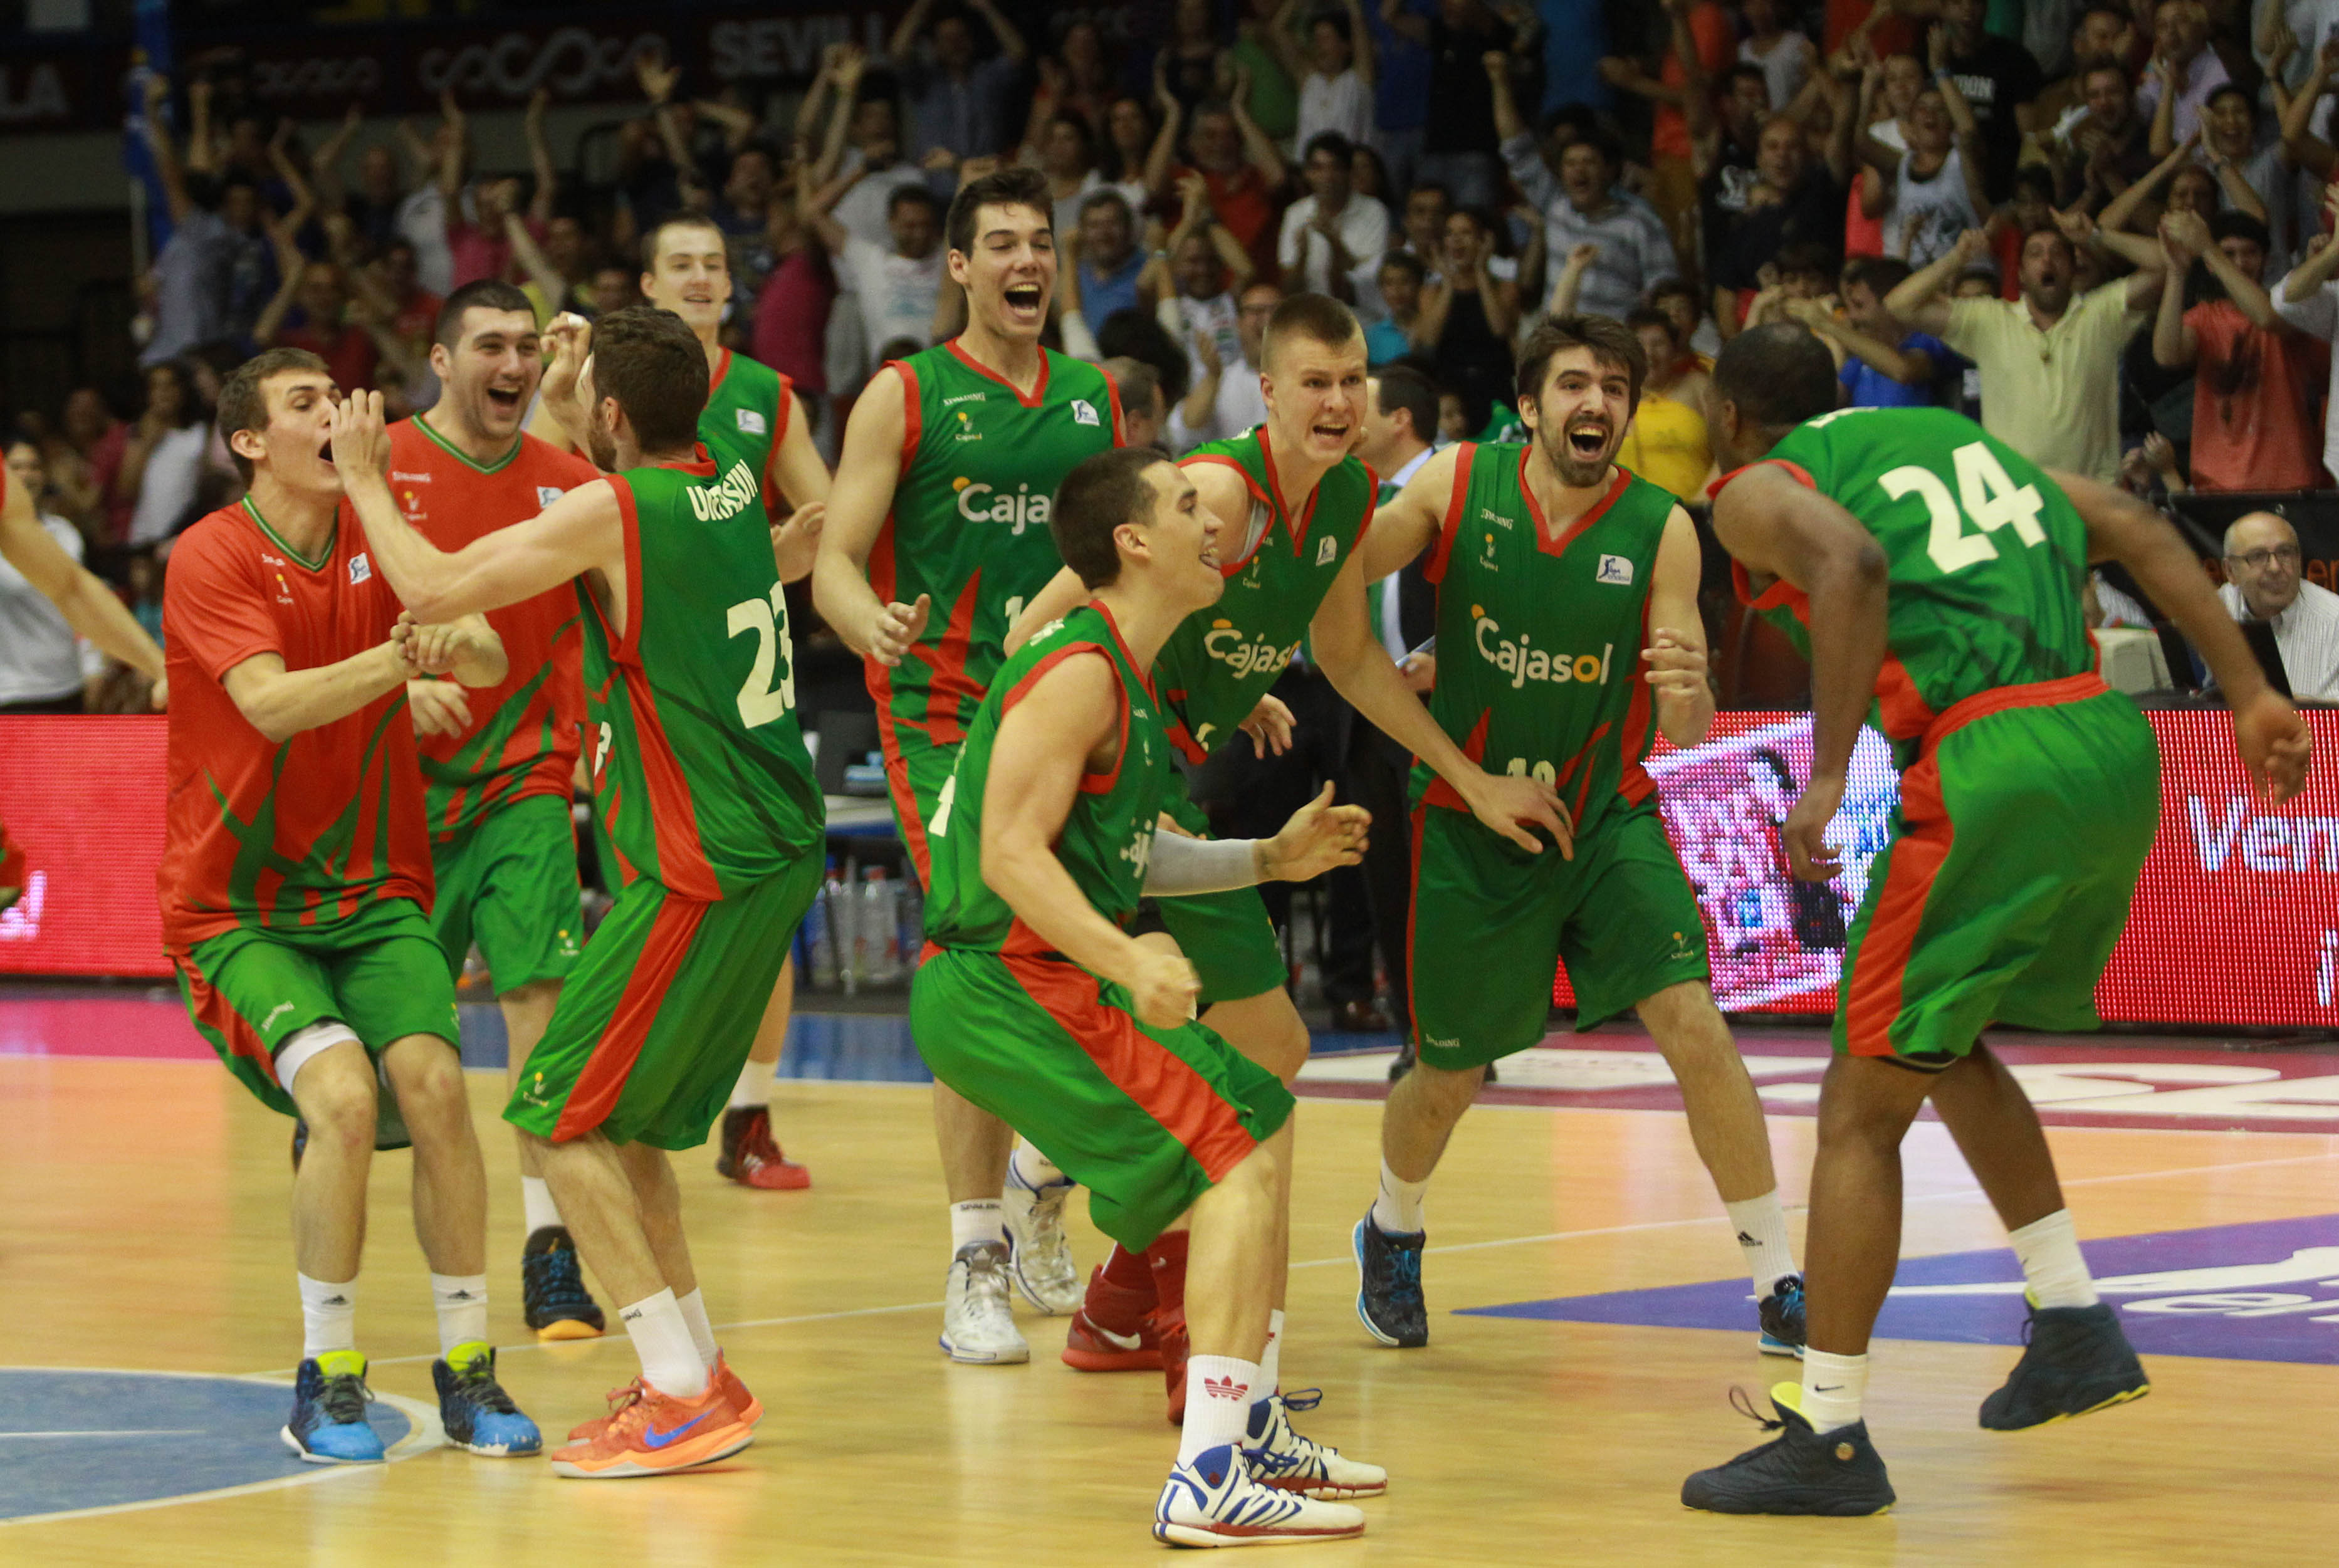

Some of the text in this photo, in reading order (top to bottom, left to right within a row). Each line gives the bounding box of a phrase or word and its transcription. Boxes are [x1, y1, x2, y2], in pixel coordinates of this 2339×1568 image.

[958, 483, 1051, 536] Caja
[1877, 440, 2048, 575] 24
[727, 580, 795, 729] 23
[1203, 629, 1302, 680] Cajas
[1475, 617, 1613, 689] Cajasol
